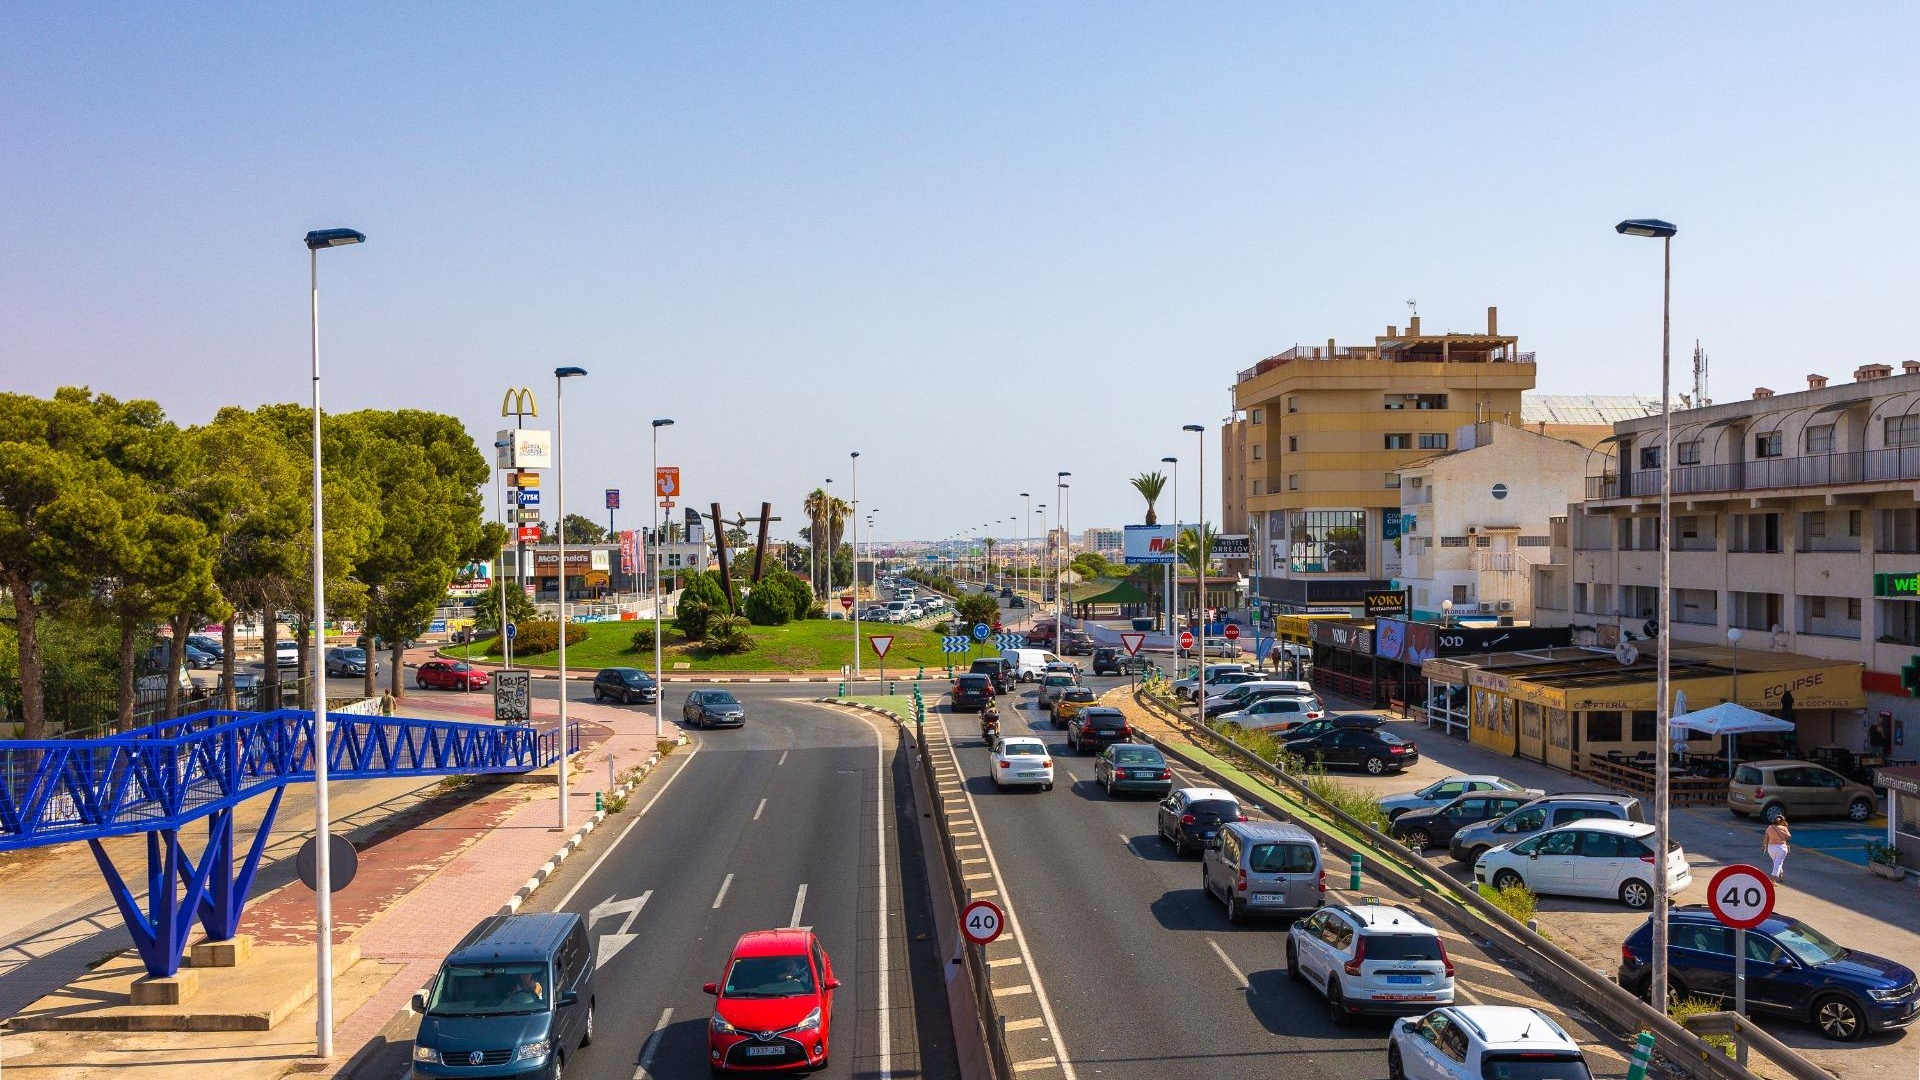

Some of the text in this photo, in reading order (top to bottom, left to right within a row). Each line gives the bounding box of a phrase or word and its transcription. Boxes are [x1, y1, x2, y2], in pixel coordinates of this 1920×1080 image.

[522, 493, 539, 501] JYSK
[538, 554, 589, 563] McDnald's
[1368, 595, 1404, 606] YOKU
[1763, 672, 1824, 700] ECLIPSE
[1877, 772, 1918, 794] Restaurante
[1721, 886, 1761, 908] 40
[969, 915, 995, 930] 40
